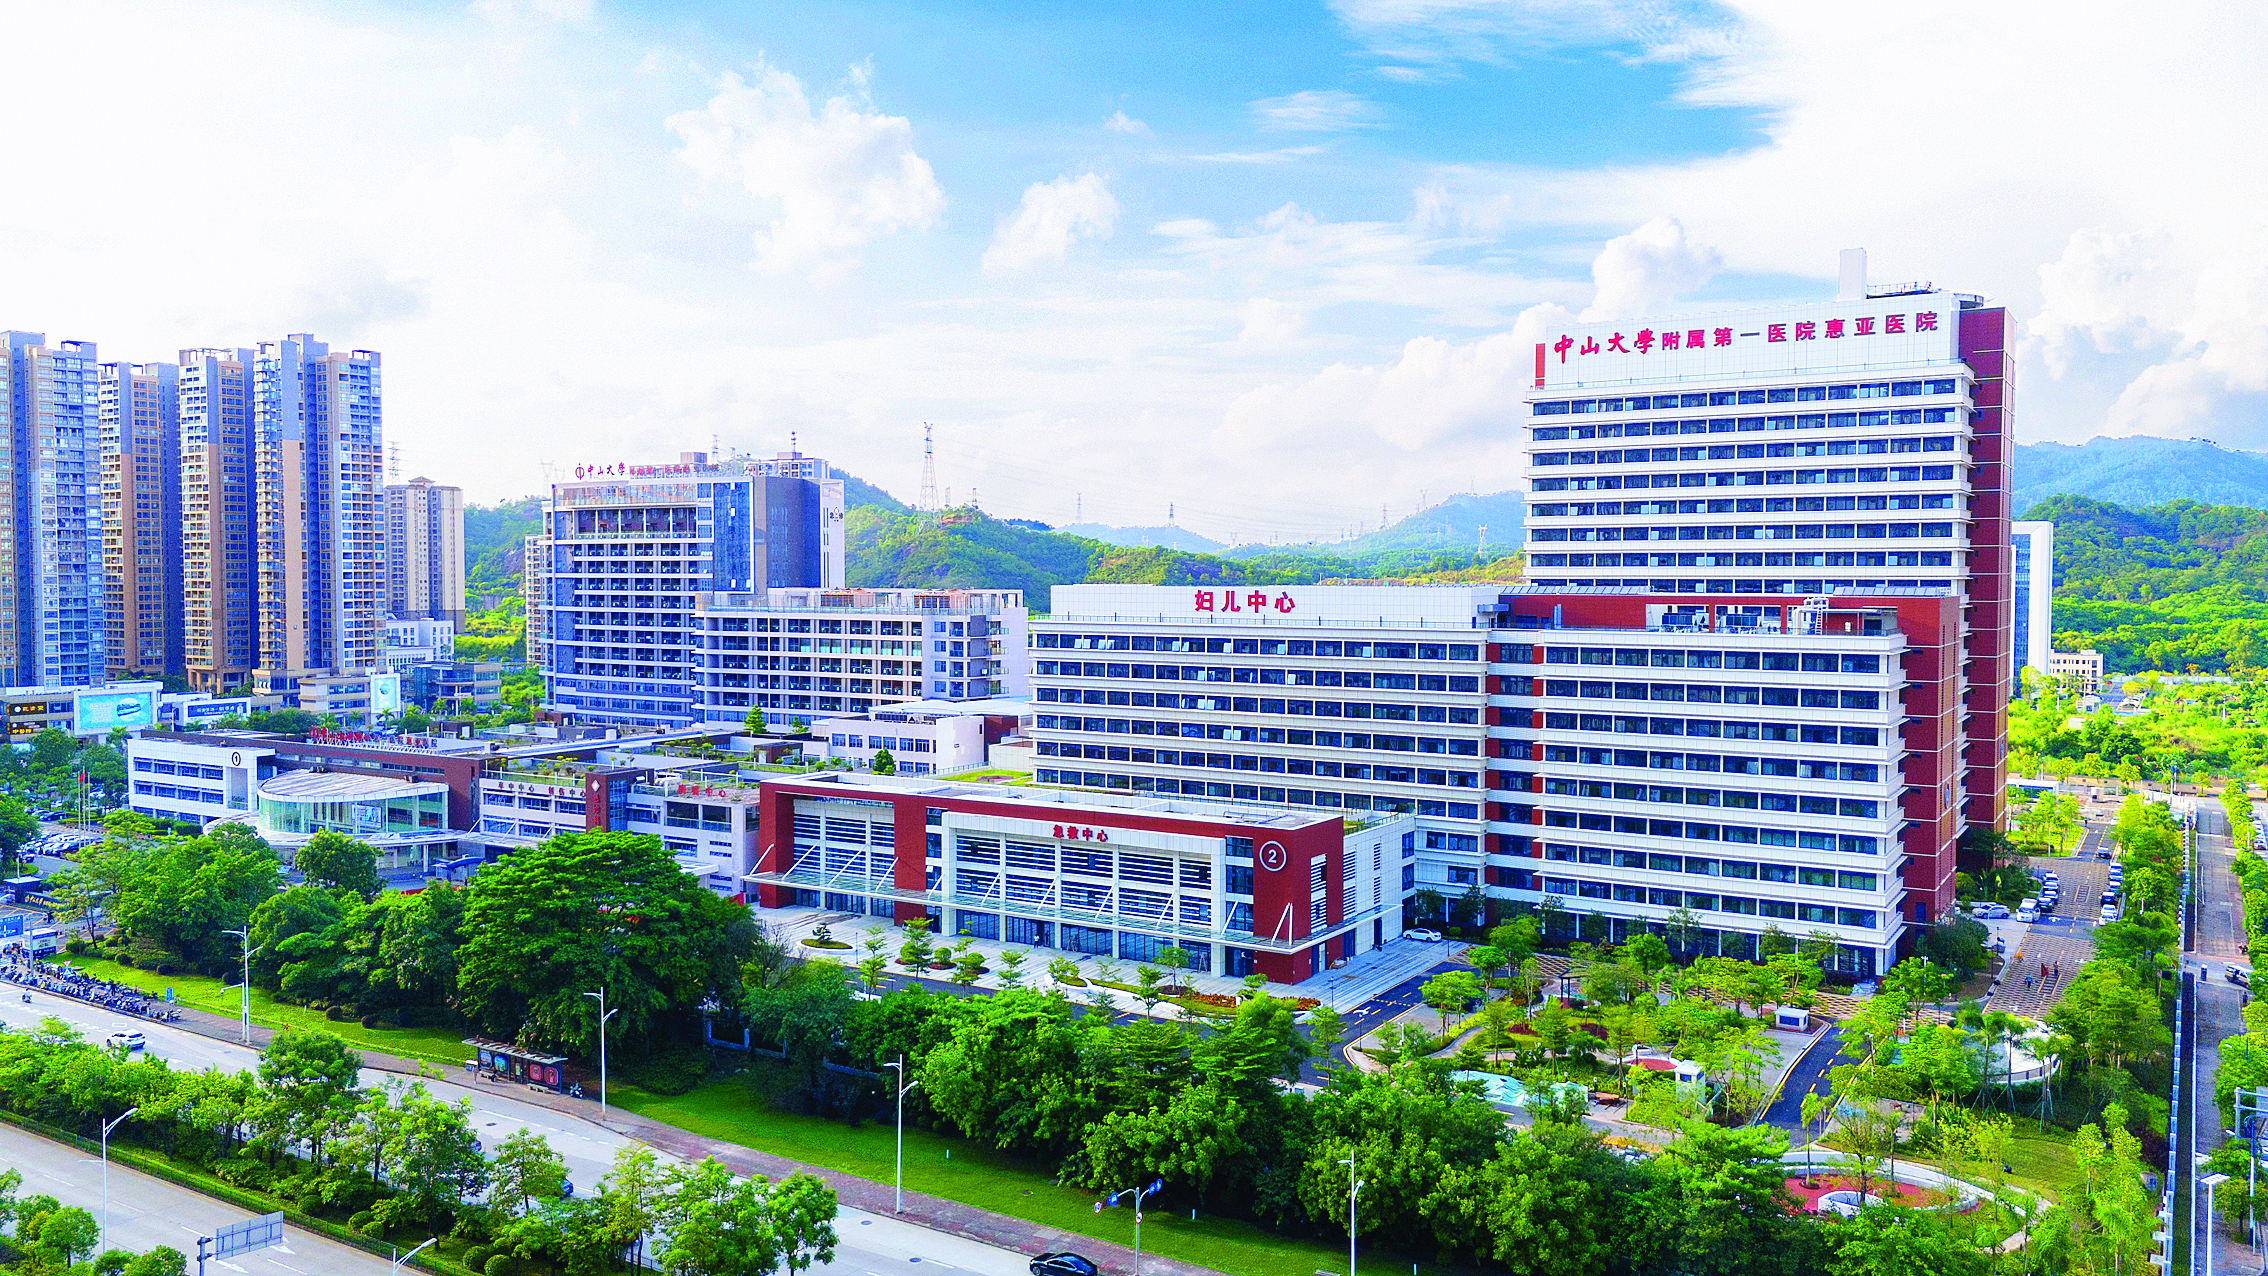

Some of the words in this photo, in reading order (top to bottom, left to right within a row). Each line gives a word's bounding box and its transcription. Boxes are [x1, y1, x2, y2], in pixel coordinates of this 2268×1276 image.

[1194, 590, 1296, 613] 妇儿中心
[1053, 824, 1109, 842] 急救中心
